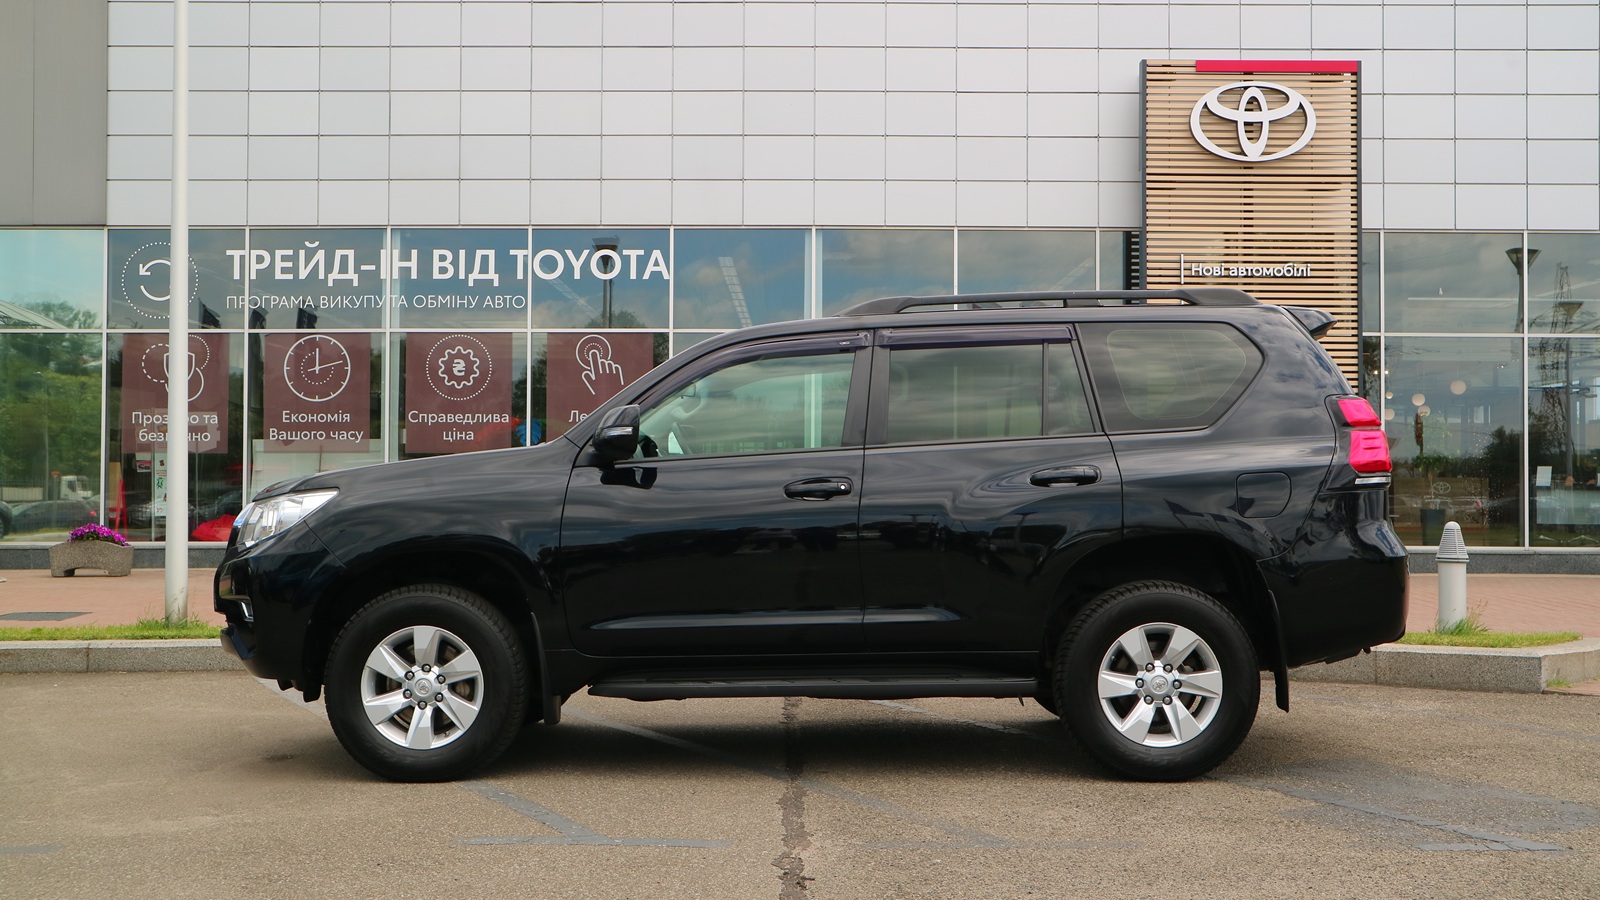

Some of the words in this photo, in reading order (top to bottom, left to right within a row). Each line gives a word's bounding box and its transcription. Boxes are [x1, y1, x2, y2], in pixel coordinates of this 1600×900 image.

[226, 241, 418, 287] ТРЕЙД-ІН
[432, 249, 499, 287] ВІД
[509, 249, 670, 280] TOYOTA
[1191, 263, 1225, 276] Нові
[1229, 263, 1311, 277] автомобілі
[226, 295, 315, 309] ПРОГРАМА
[321, 295, 386, 309] ВИКУПУ
[389, 295, 408, 308] ТА
[413, 294, 479, 309] ОБМІНУ
[483, 294, 526, 309] АВТО
[132, 411, 200, 427] Прозо
[203, 414, 218, 424] та
[282, 410, 350, 423] Економія
[408, 410, 509, 426] Справедлива
[138, 428, 211, 442] безно
[269, 428, 325, 441] Вашого
[330, 430, 364, 443] часу
[442, 427, 474, 443] ціна
